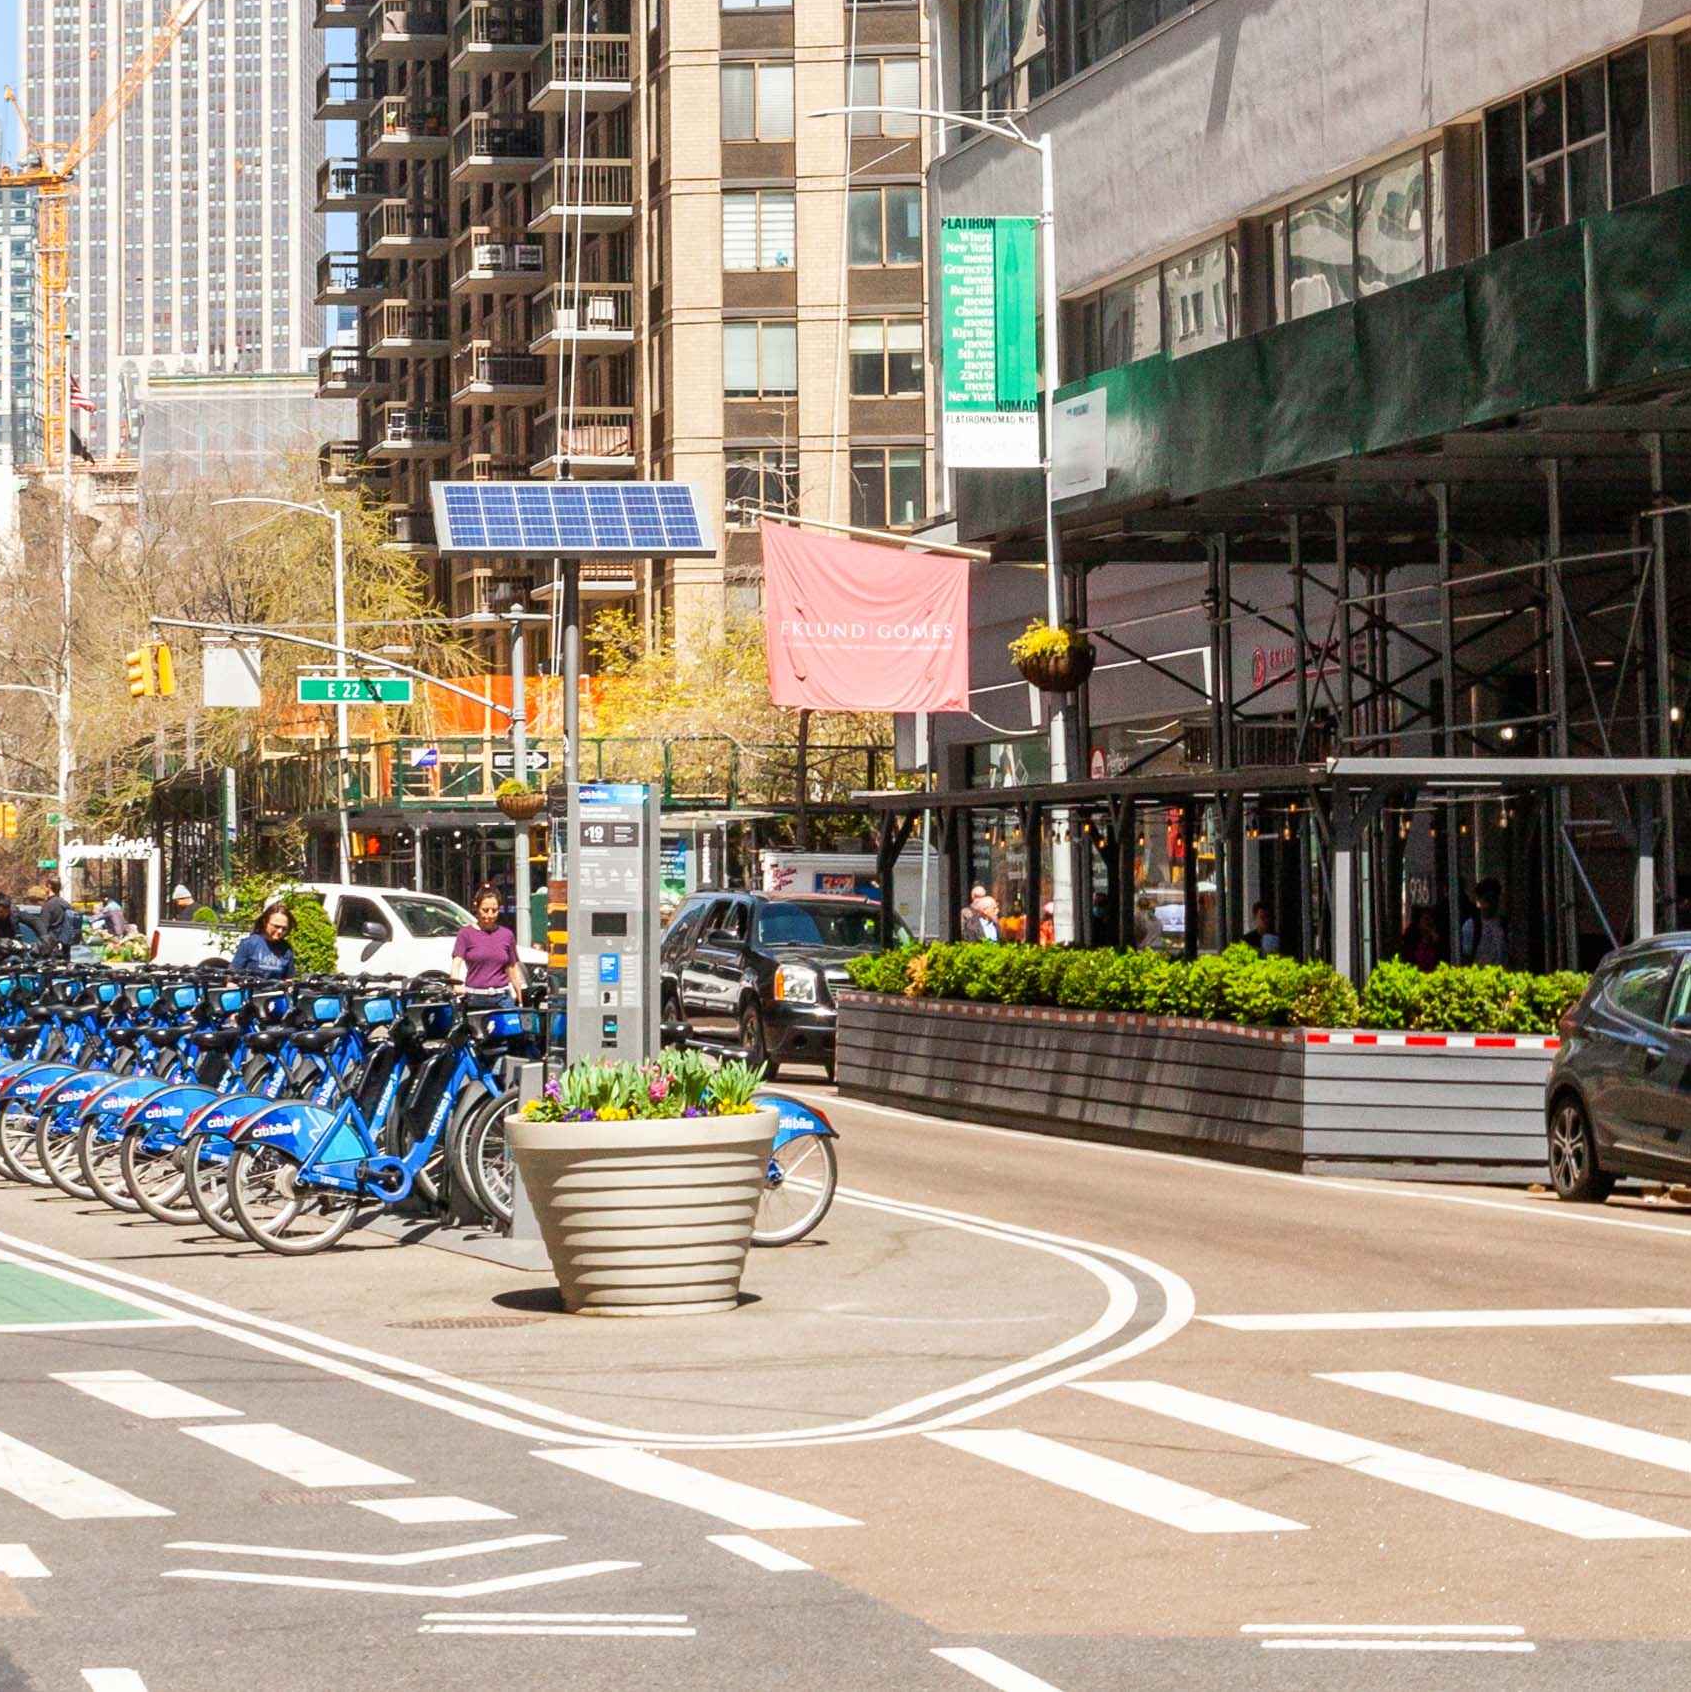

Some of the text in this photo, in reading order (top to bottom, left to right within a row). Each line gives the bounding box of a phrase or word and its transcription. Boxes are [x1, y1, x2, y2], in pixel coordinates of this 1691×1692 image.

[941, 218, 996, 230] FLATIRON
[946, 243, 993, 253] New York
[964, 255, 993, 264] meets
[957, 349, 995, 359] 5th Ave
[959, 370, 995, 381] 23rd St
[948, 391, 995, 402] New York
[996, 400, 1037, 413] NOMAD
[780, 620, 954, 640] EKLUND GOMES
[328, 683, 382, 698] E 22 St
